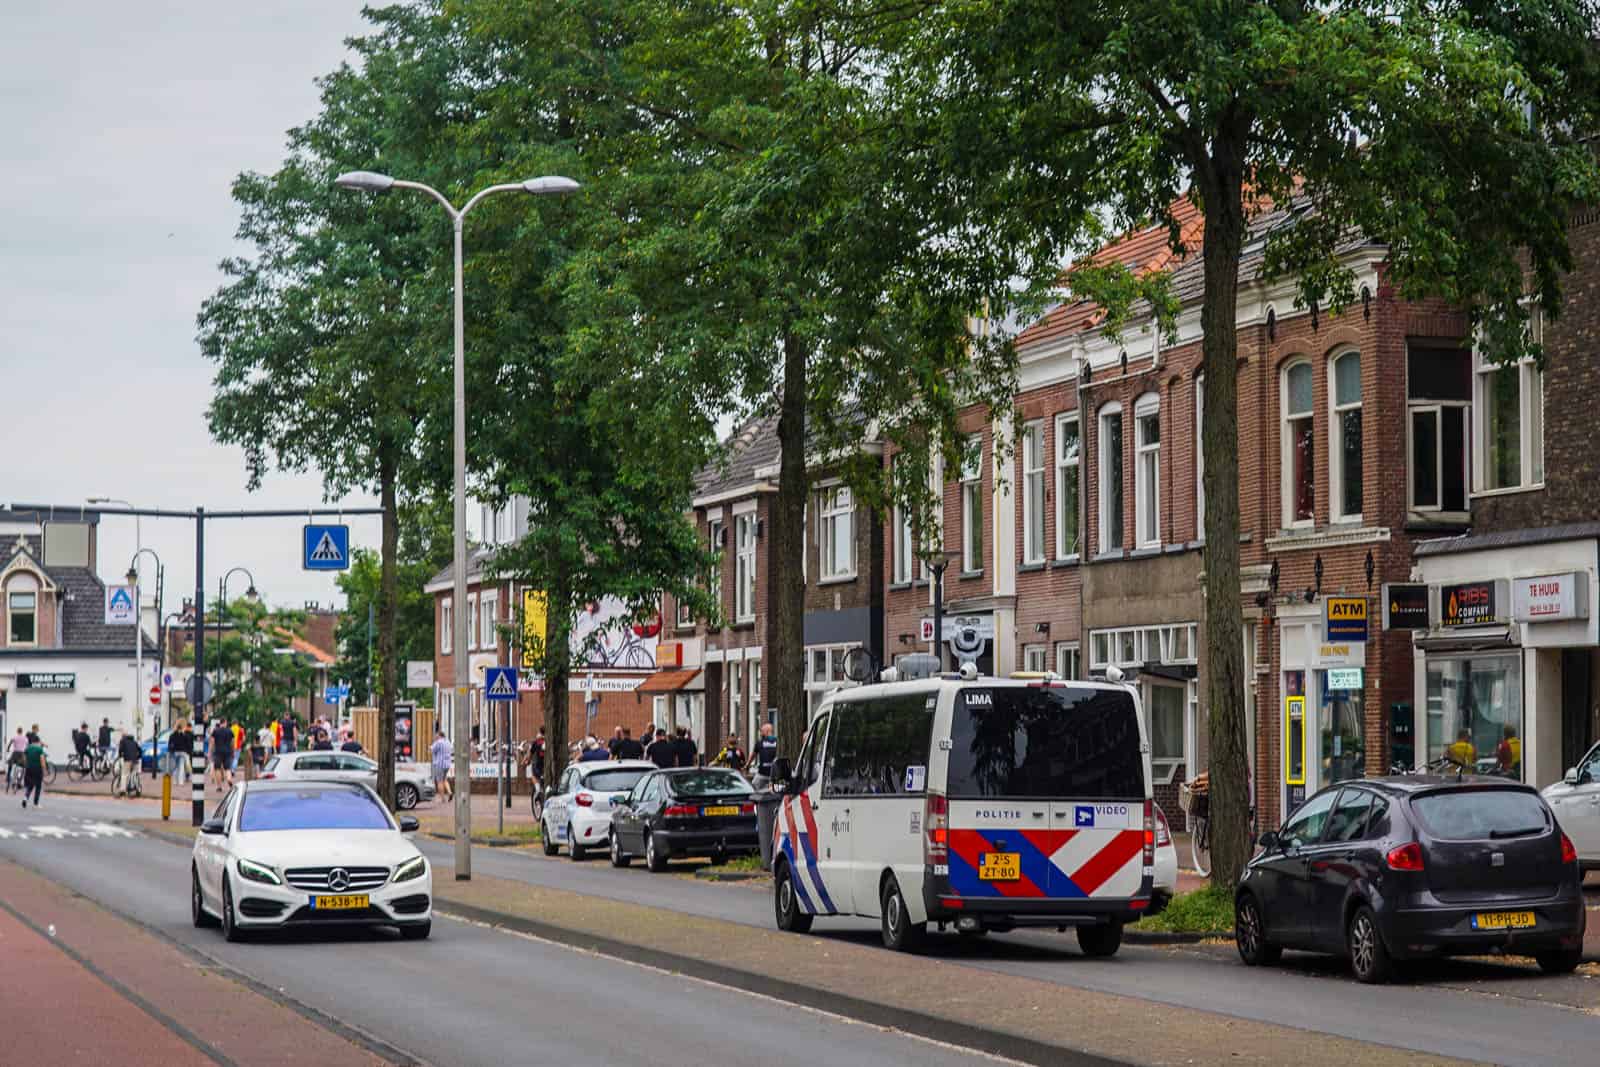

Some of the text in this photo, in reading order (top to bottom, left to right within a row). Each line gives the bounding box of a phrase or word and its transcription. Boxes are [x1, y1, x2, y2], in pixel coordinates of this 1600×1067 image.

[1529, 582, 1560, 597] TE HUUR
[1332, 603, 1363, 615] ATM
[1459, 606, 1489, 617] COMPANY
[965, 694, 992, 705] LIMA
[976, 810, 1021, 819] POLITIE
[1096, 805, 1127, 815] VIDEO
[984, 867, 1015, 878] ZT-80
[320, 896, 366, 907] N-538-TT
